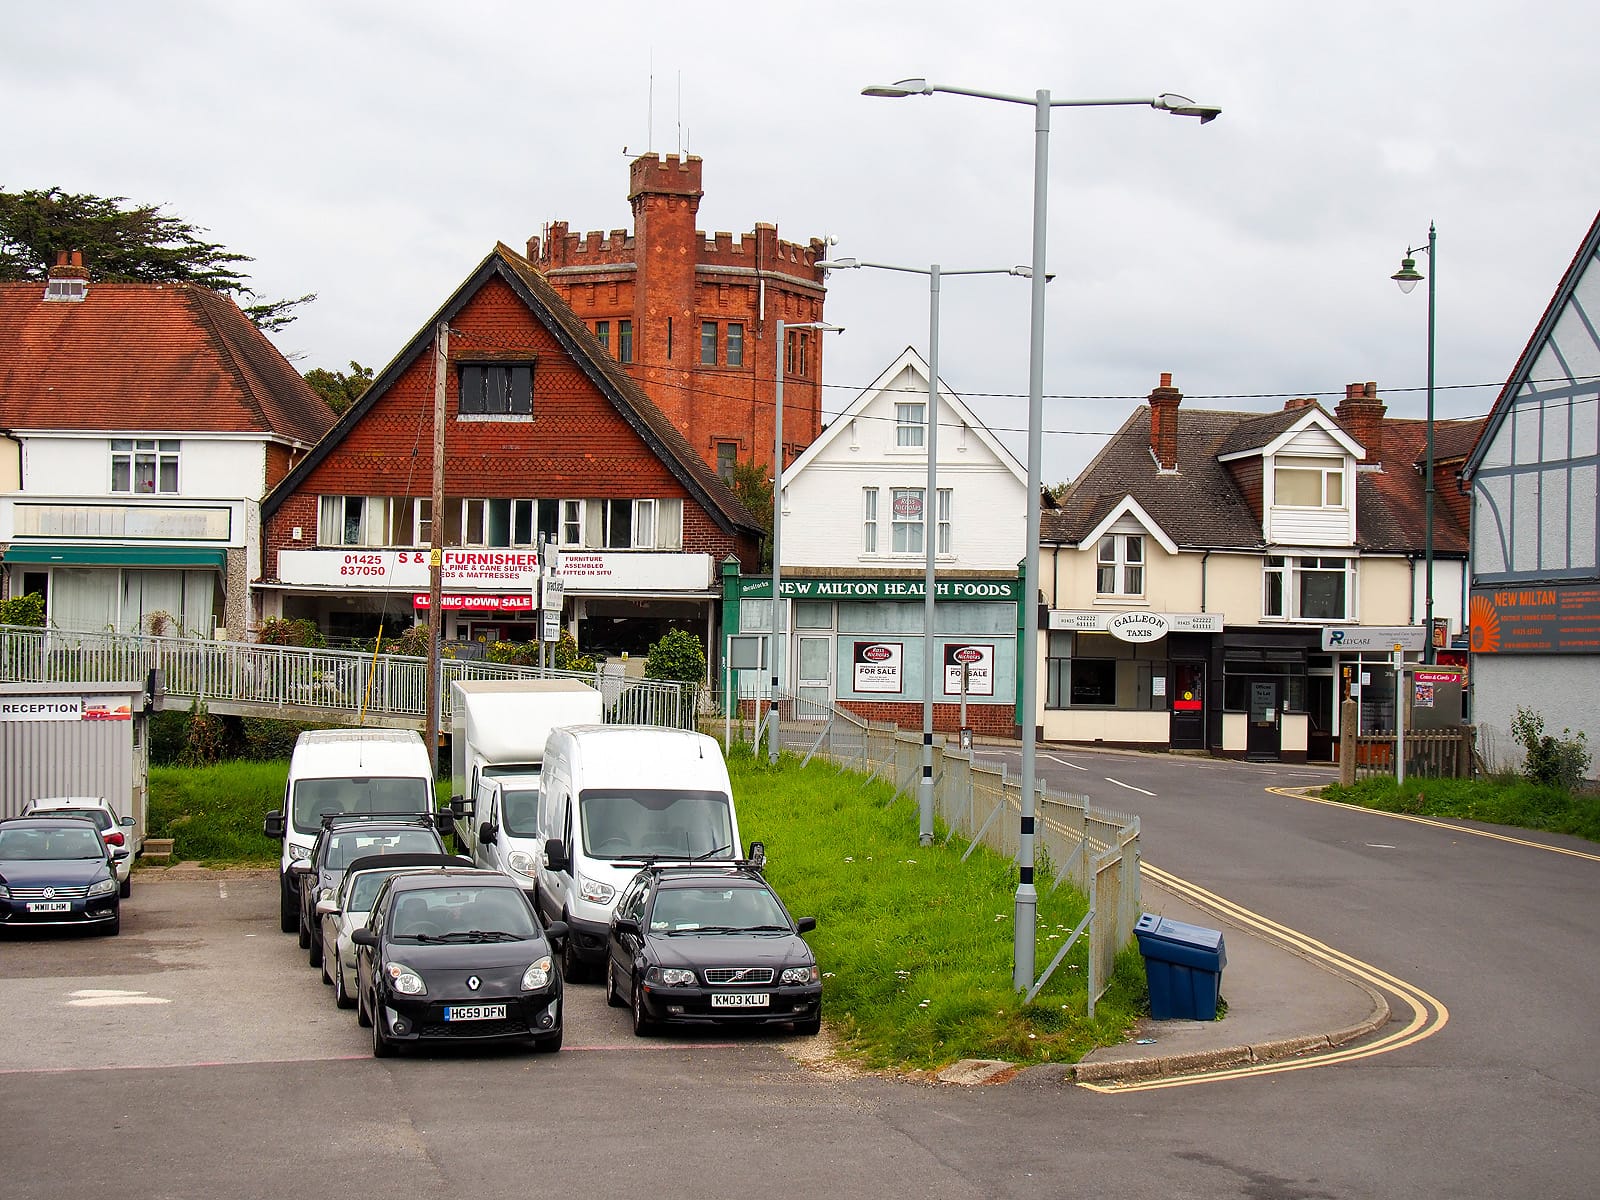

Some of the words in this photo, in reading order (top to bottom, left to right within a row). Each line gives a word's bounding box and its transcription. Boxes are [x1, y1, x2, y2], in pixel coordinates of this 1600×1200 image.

[344, 555, 382, 564] 01425
[398, 552, 409, 564] S
[413, 552, 425, 564] &
[445, 553, 538, 566] FURNISHER
[340, 566, 386, 576] 837050
[504, 565, 536, 573] SUITES,
[466, 571, 520, 579] MATTRESSES
[779, 582, 812, 594] NEW
[816, 582, 879, 595] MILTON
[884, 582, 949, 595] HEALH
[953, 583, 1012, 596] FOODS
[416, 596, 462, 606] CLING
[464, 597, 498, 606] DOWN
[502, 598, 530, 607] SALE
[1494, 591, 1518, 607] NEW
[1519, 589, 1557, 607] MILTAN
[1114, 614, 1165, 628] GALLEON
[2, 704, 78, 713] RECEPTION
[714, 995, 743, 1005] KM03
[745, 995, 765, 1005] KLU
[451, 1007, 481, 1019] HG59
[483, 1006, 505, 1018] DFN
